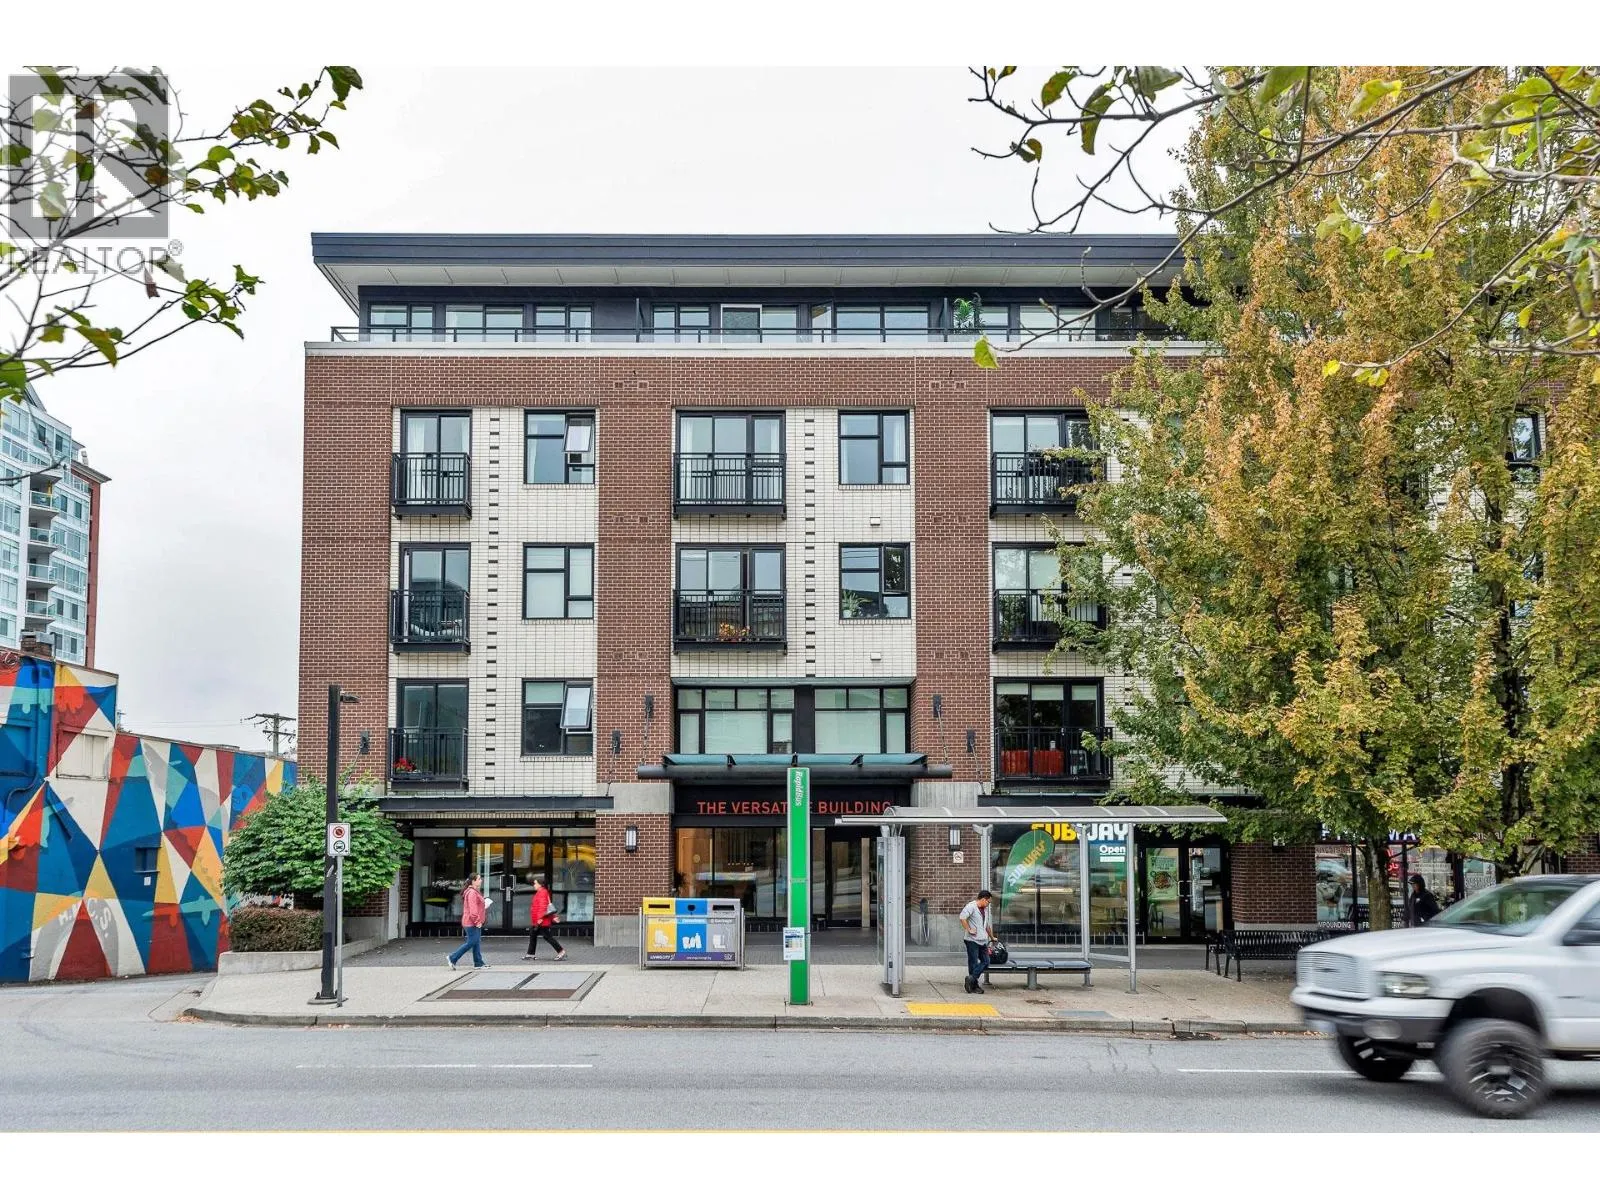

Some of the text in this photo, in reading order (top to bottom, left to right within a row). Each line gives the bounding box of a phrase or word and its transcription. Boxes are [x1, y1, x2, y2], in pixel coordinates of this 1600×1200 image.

[697, 802, 891, 814] THE VERSAT BUILDING
[1099, 845, 1126, 854] Open
[1007, 840, 1046, 886] SUBWAY
